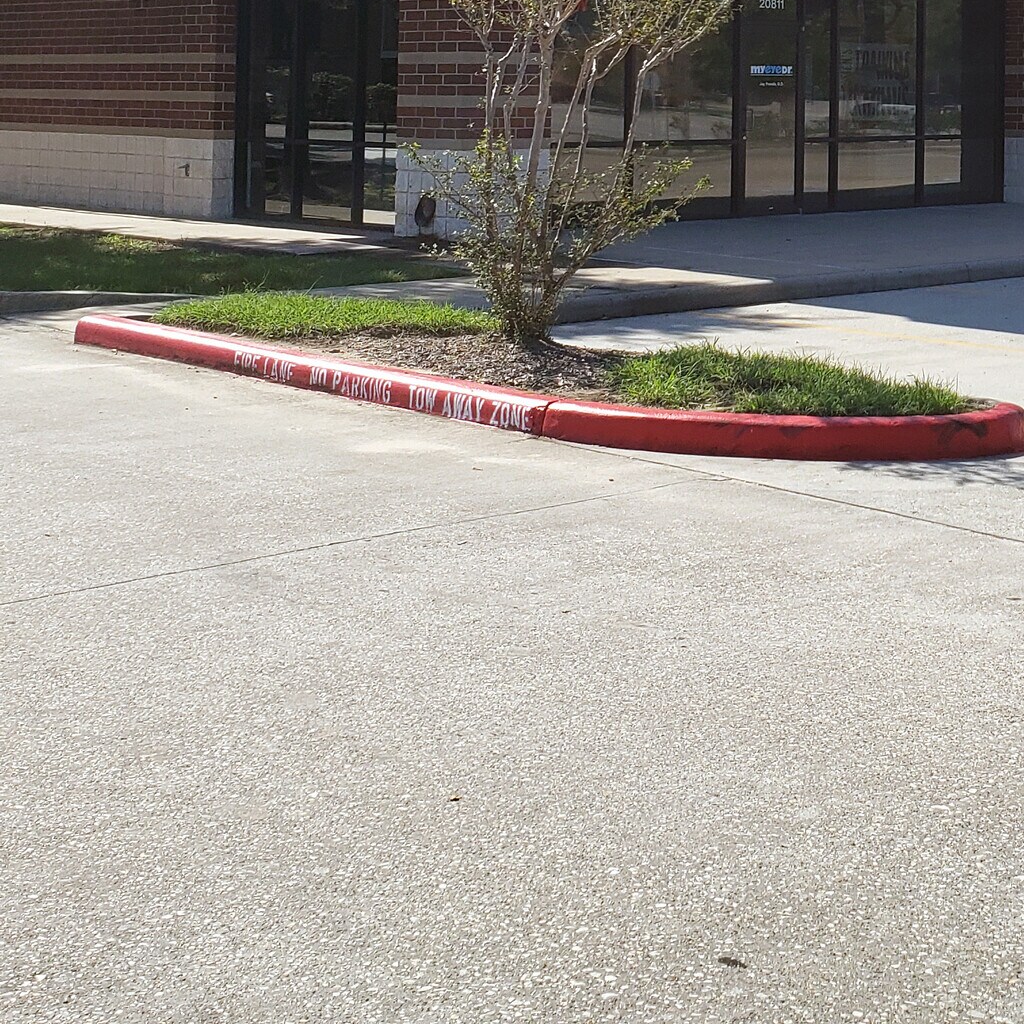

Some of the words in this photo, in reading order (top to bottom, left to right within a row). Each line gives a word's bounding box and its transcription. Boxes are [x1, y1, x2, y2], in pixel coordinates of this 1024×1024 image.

[234, 350, 261, 372] FIRE
[263, 357, 296, 383] LANE
[309, 366, 328, 387] NO
[332, 370, 392, 404] PARKING
[408, 385, 438, 414] TOW
[441, 392, 485, 422] AWAY
[489, 401, 532, 431] ZONE
